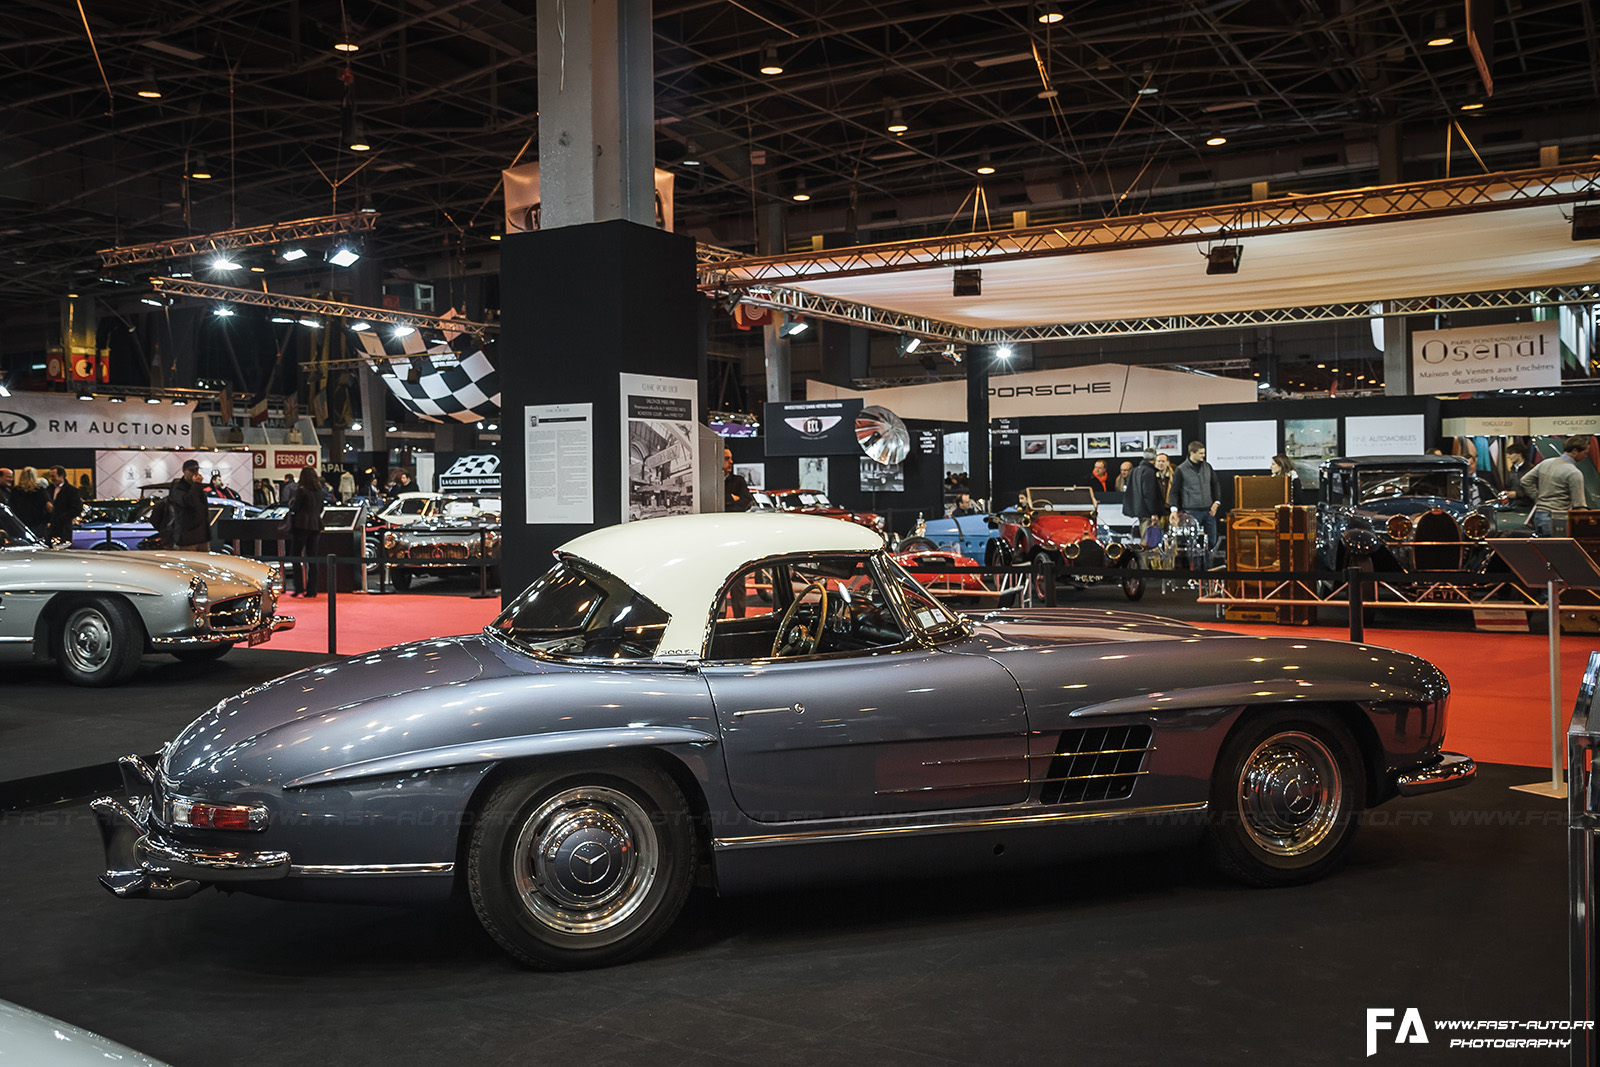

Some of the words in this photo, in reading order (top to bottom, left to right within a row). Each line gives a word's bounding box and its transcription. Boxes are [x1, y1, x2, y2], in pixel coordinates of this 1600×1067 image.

[1421, 334, 1549, 364] Osenat
[1419, 370, 1449, 379] Maison
[1465, 367, 1494, 375] Ventes
[1515, 363, 1555, 372] Enchères
[1454, 376, 1487, 385] Auction
[1491, 374, 1519, 382] House
[988, 382, 1111, 397] PORSCHE
[49, 420, 78, 433] RM
[89, 422, 190, 436] AUCTIONS
[1369, 434, 1417, 442] AUTOMOBILES
[276, 454, 305, 465] FERRARI
[307, 455, 314, 464] 4
